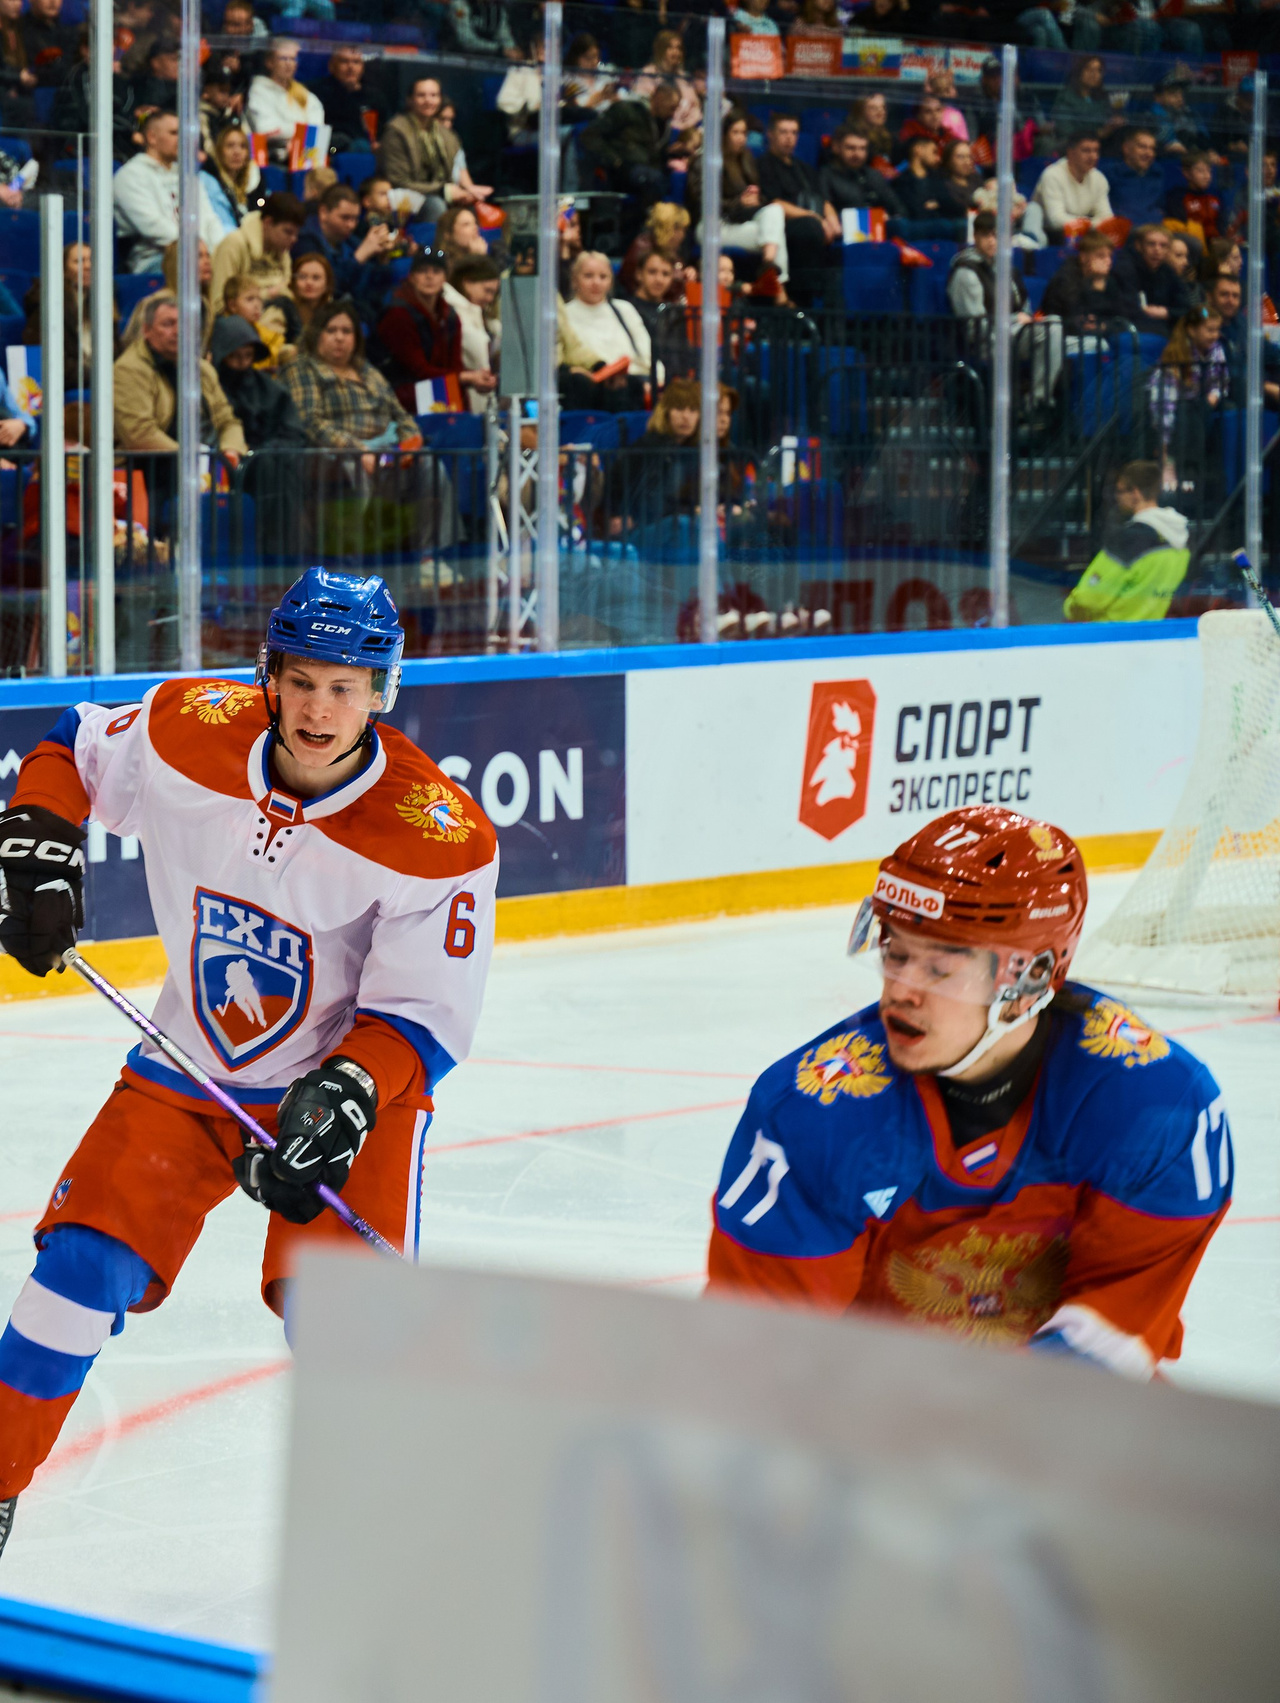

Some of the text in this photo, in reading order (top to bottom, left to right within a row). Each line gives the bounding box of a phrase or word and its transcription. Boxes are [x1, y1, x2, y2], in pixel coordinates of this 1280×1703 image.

[310, 621, 353, 636] CCM
[895, 697, 1041, 763] СПОРТ
[890, 768, 1032, 813] ЭКСПРЕСС
[443, 890, 476, 959] 6
[876, 879, 940, 914] РОЛЬФ
[200, 896, 304, 971] СХЛ
[718, 1128, 790, 1227] 17
